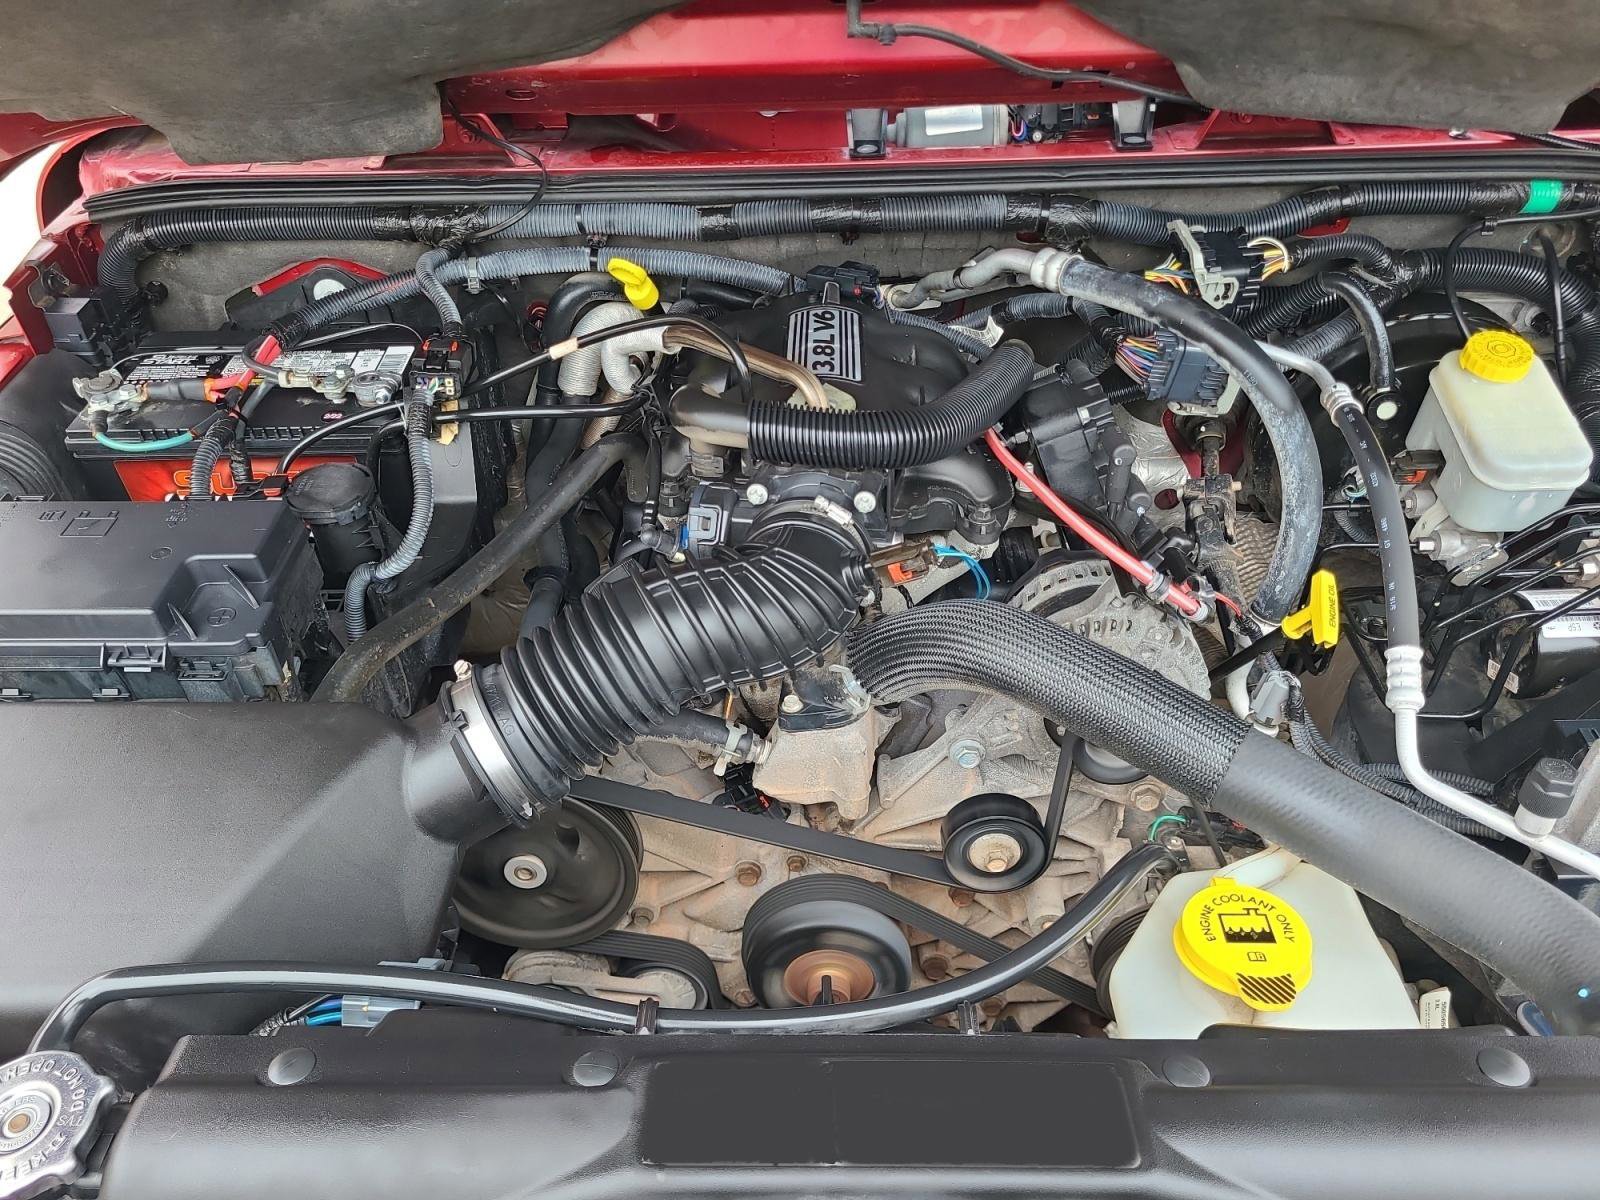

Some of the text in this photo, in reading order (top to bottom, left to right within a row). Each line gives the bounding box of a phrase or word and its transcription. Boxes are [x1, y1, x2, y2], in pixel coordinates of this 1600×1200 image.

[812, 309, 836, 373] 3.8L V6
[1328, 584, 1337, 629] ENGINE OIL
[1199, 893, 1296, 943] ENGINE COOLANT ONLY
[53, 1062, 84, 1090] NOT
[70, 1087, 87, 1113] DO
